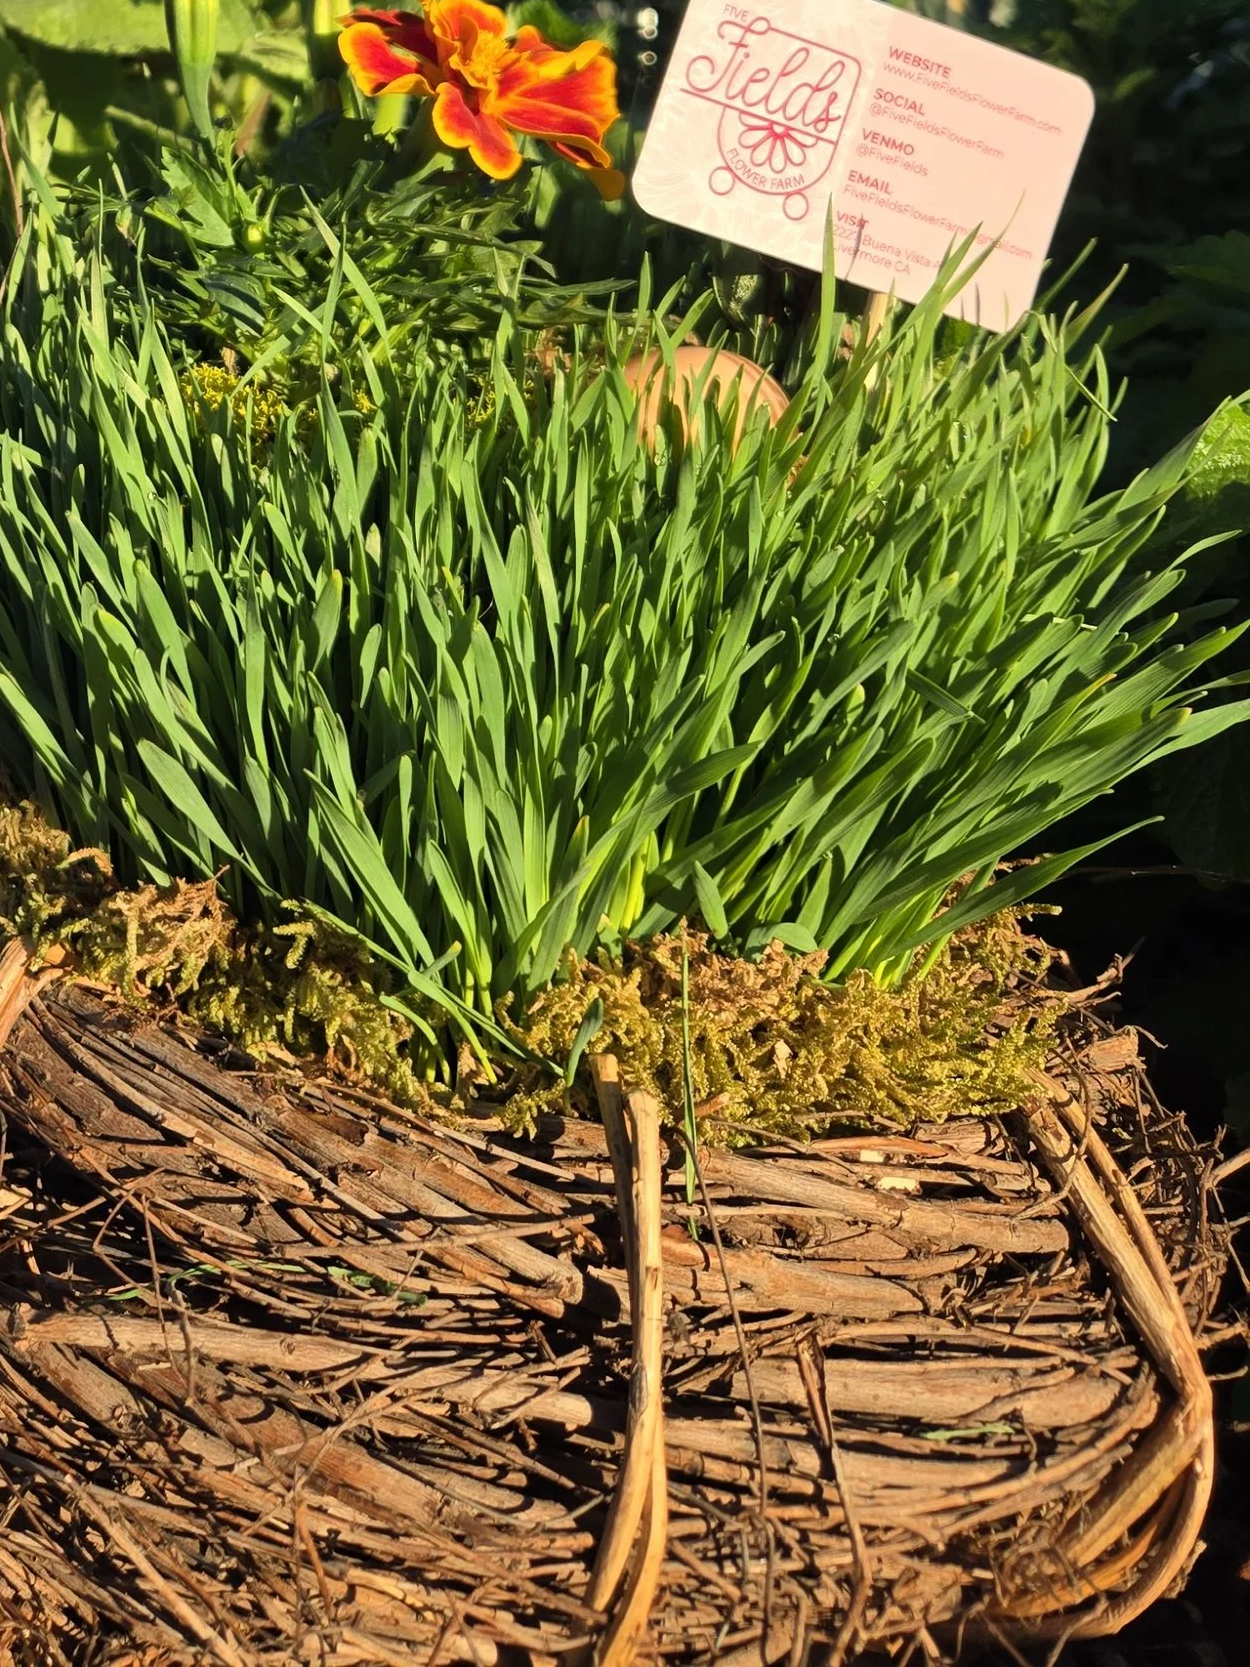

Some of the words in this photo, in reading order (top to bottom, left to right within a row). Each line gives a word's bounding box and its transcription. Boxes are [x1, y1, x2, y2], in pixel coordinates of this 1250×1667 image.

[722, 3, 750, 22] FIVE
[686, 16, 846, 134] Fields
[888, 45, 953, 79] WEBSITE
[873, 87, 927, 116] SOCIAL
[861, 128, 915, 156] VENMO
[869, 102, 1005, 158] @FiveFieldsFlowerFarm
[726, 147, 767, 189] FLOWER
[770, 174, 805, 190] FARM
[856, 143, 929, 177] @FiveFields
[847, 170, 893, 195] EMAIL
[832, 224, 860, 242] 222
[862, 234, 902, 257] Buena
[904, 248, 931, 267] Vista
[834, 240, 892, 268] ivemore
[894, 260, 911, 275] CA
